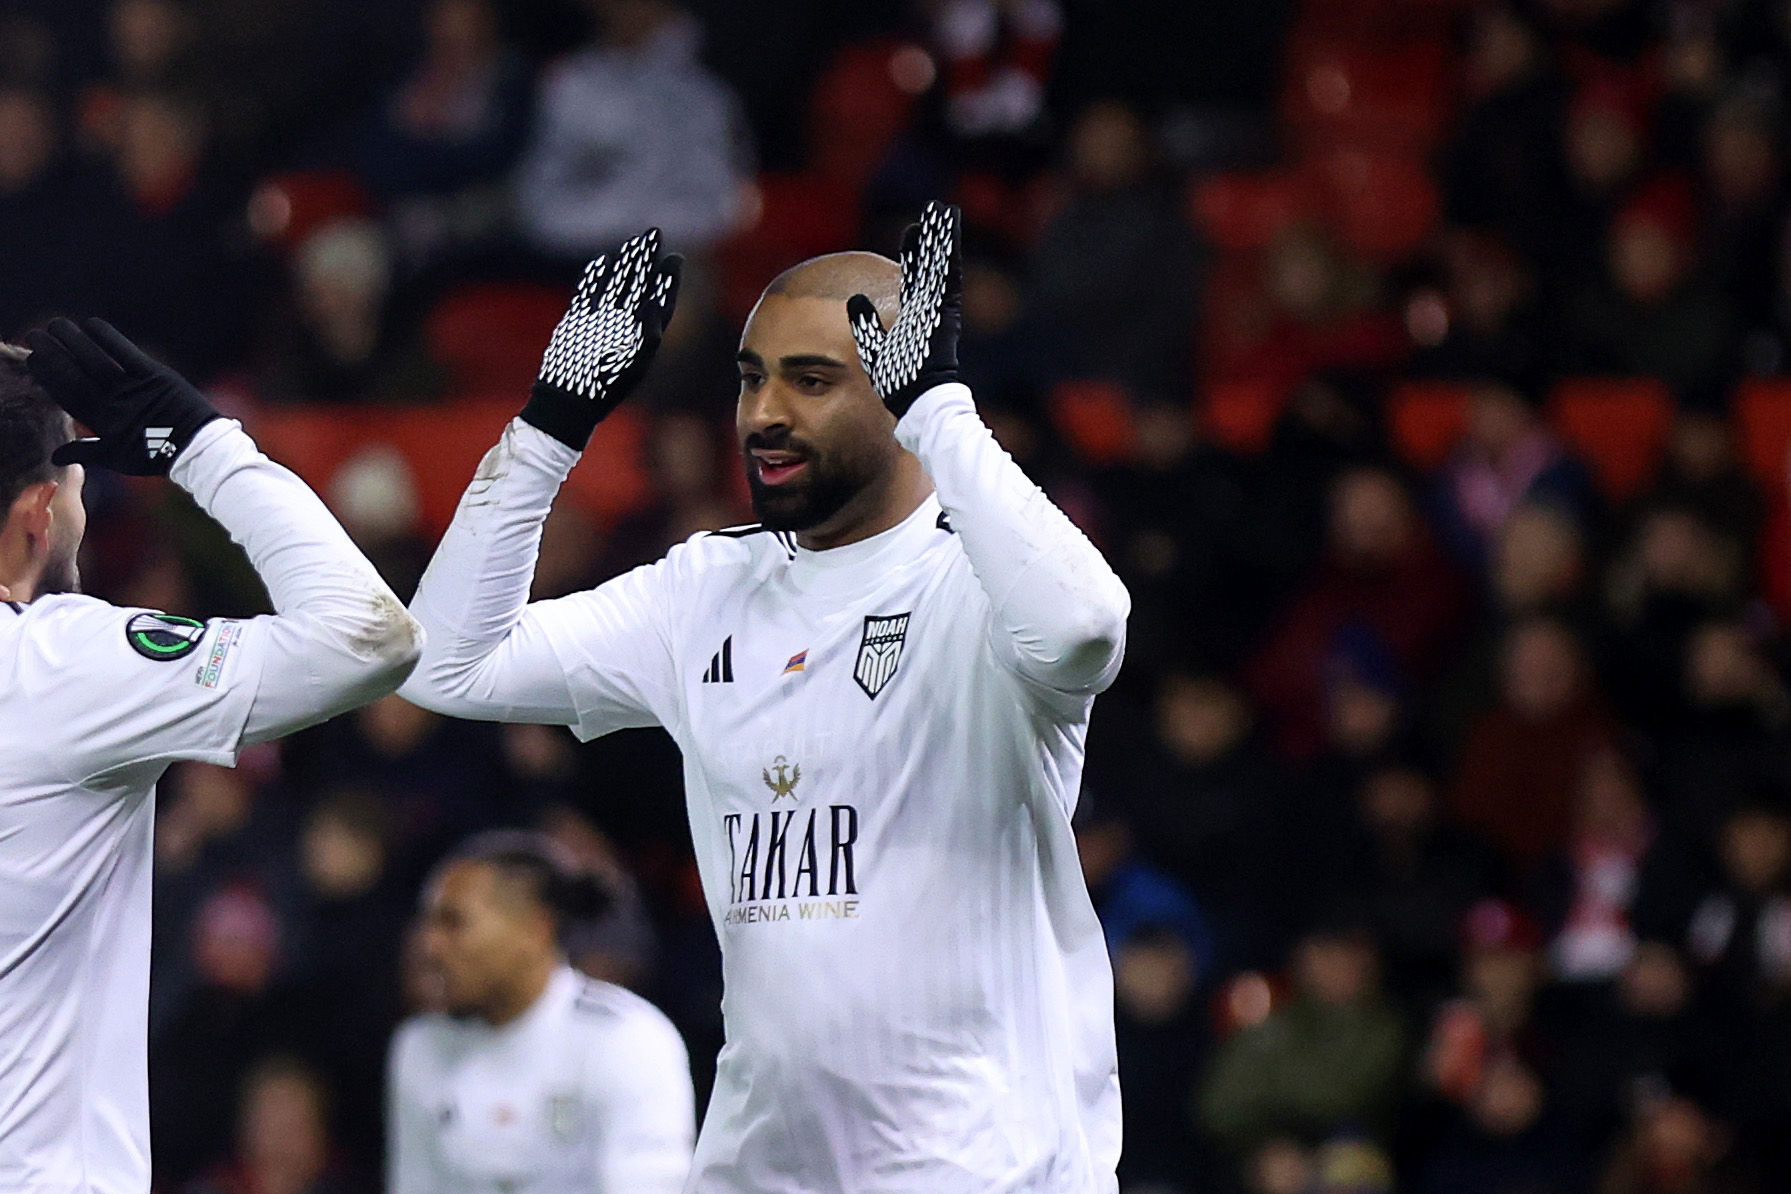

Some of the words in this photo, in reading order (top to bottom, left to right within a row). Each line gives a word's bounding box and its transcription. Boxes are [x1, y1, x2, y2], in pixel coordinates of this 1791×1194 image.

[867, 617, 908, 639] NOAH
[723, 804, 859, 904] TAKAR
[799, 901, 860, 920] WINE
